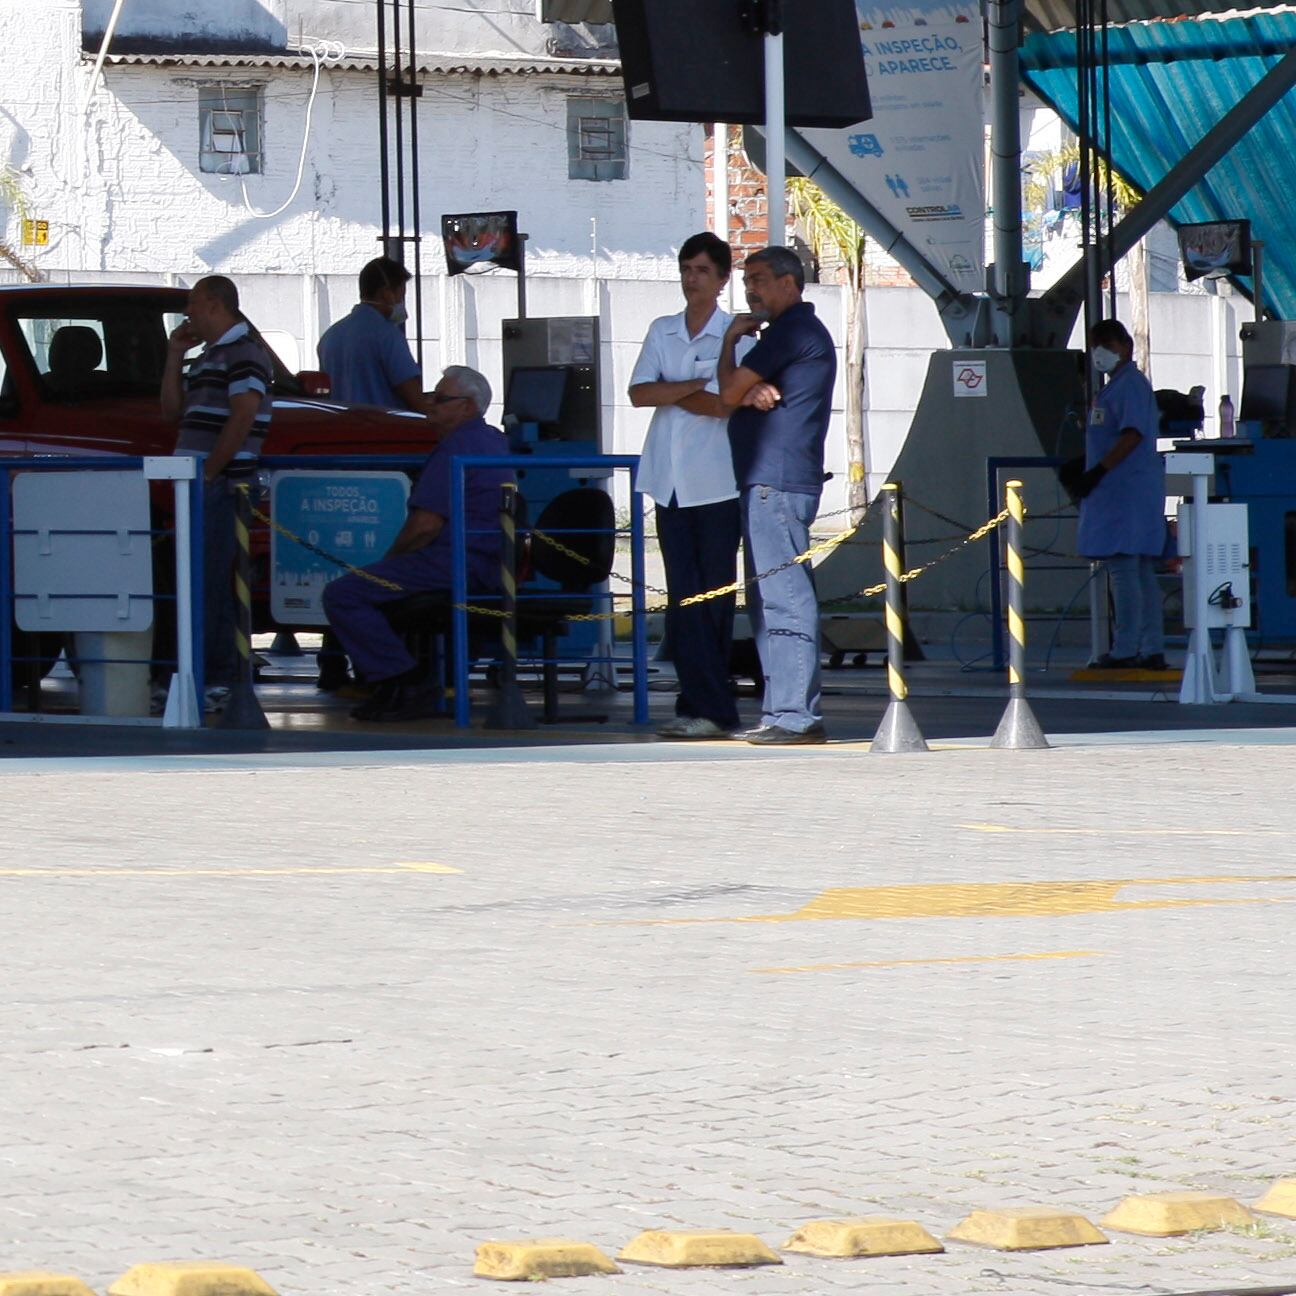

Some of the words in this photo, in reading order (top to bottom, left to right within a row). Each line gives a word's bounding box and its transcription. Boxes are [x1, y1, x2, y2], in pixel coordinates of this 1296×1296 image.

[874, 33, 963, 55] INSPEÇÃO,
[878, 56, 958, 75] APARECE.
[325, 486, 360, 497] TODOS
[301, 499, 310, 511] A
